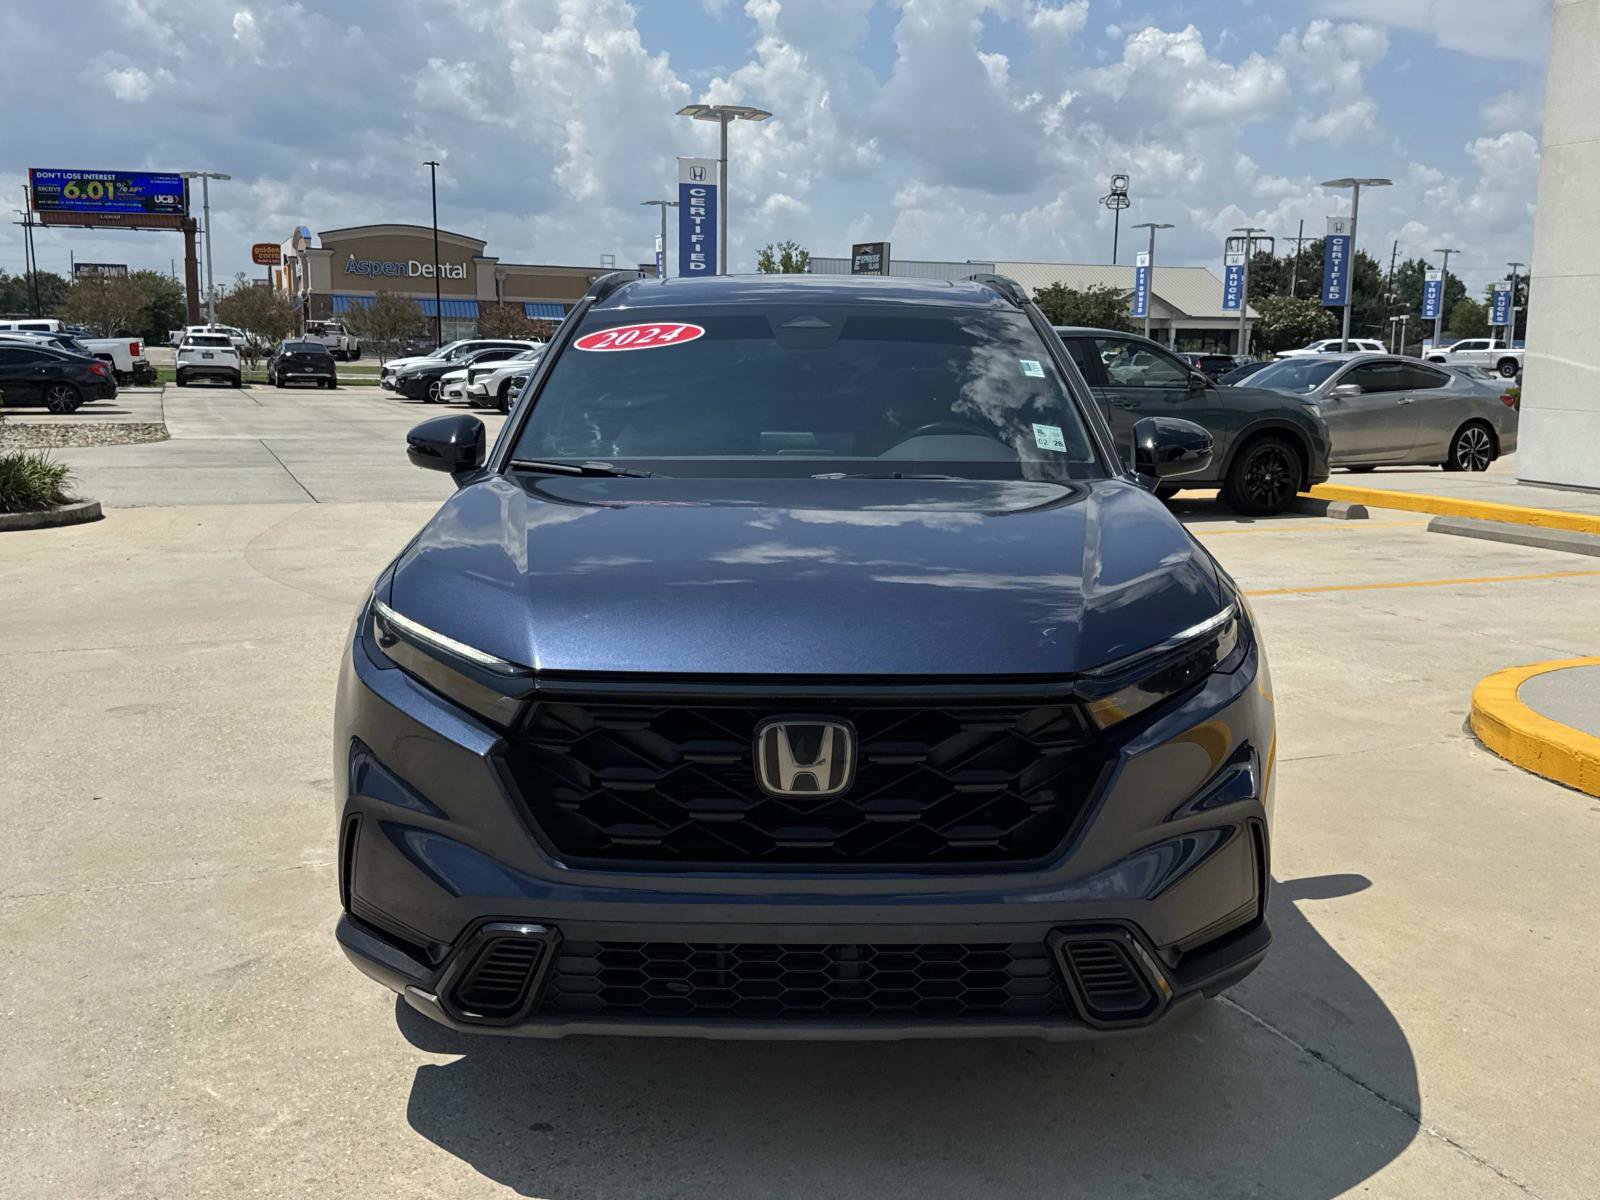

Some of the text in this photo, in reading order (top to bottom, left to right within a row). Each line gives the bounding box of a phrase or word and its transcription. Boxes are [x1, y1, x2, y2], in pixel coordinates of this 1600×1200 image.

[36, 171, 116, 181] DON'T LOSE INTEREST
[154, 194, 174, 204] UCB
[689, 188, 706, 270] CERTIFIED
[1328, 238, 1343, 300] CERTIFIED
[1227, 267, 1238, 307] TRUCKS
[1426, 282, 1436, 316] TRUCKS
[1497, 292, 1506, 321] TRUCKS
[590, 325, 688, 349] 2024
